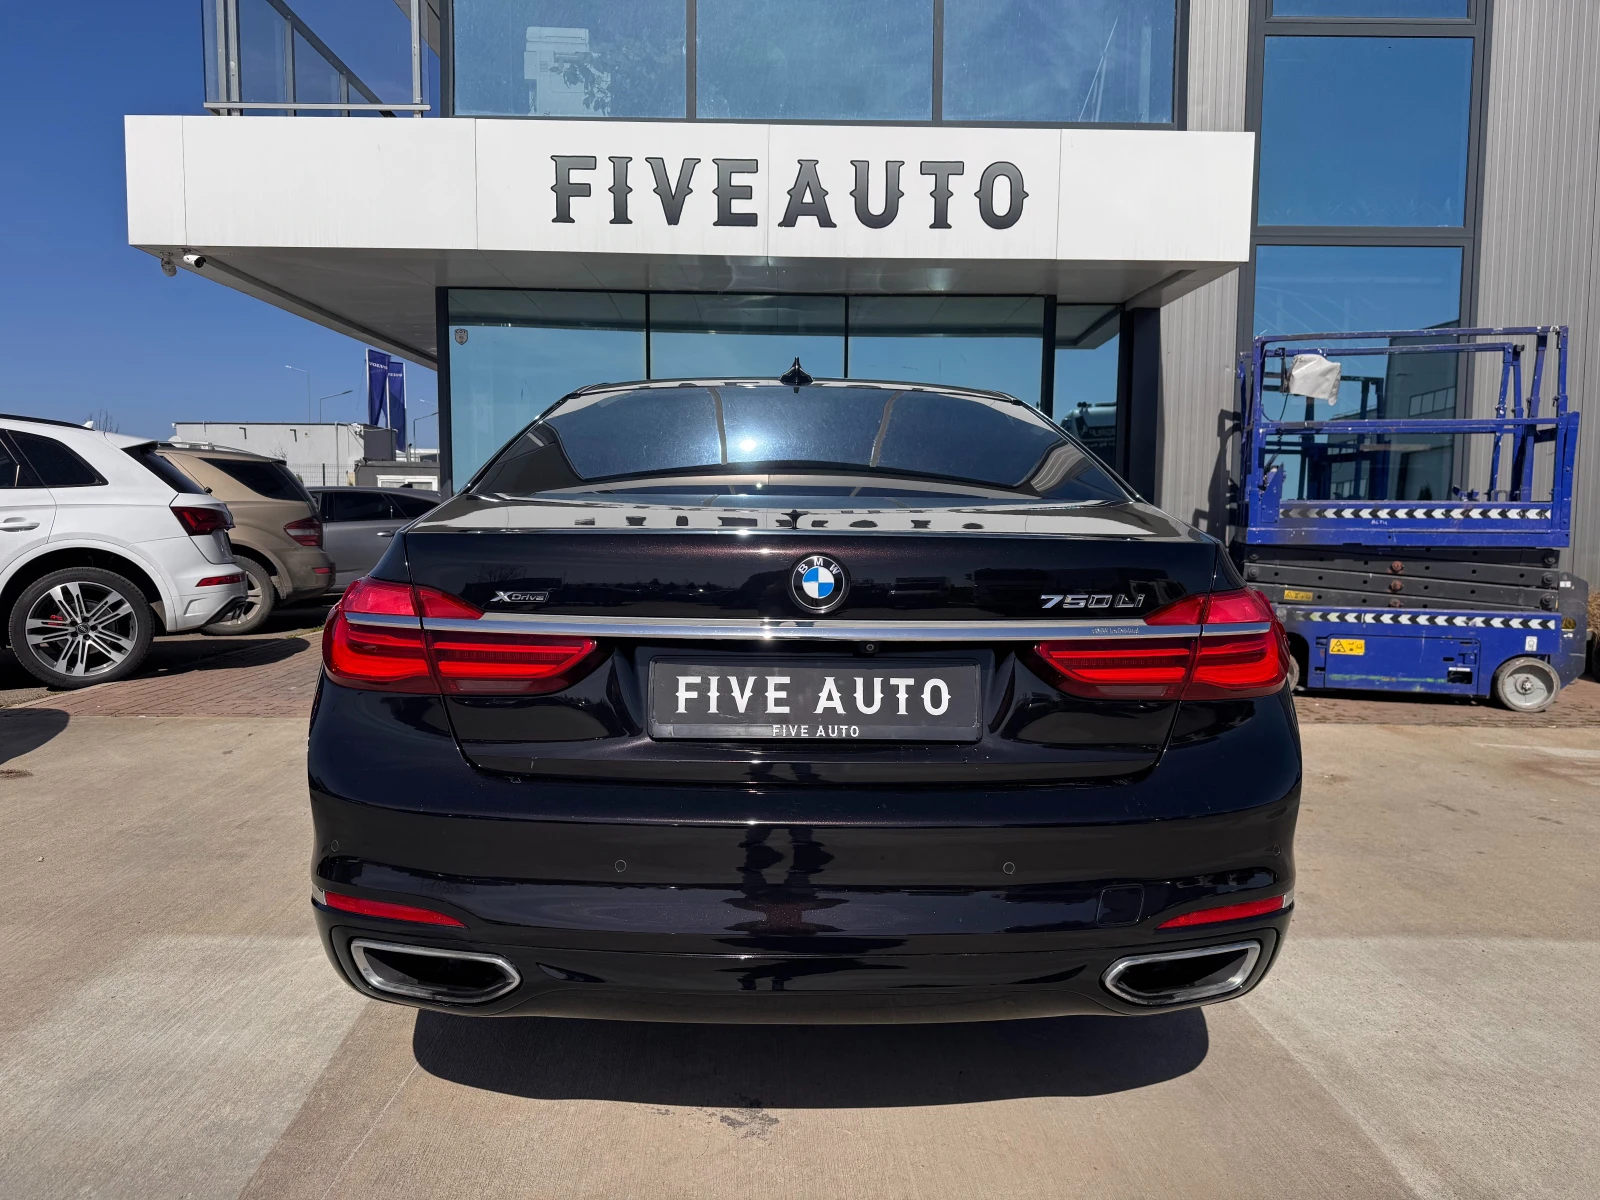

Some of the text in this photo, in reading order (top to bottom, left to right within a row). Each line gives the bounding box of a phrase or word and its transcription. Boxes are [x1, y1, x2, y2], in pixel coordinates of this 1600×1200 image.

[798, 557, 841, 575] BMW
[675, 675, 952, 716] FIVE AUTO
[772, 725, 860, 738] FIVE AUTO
